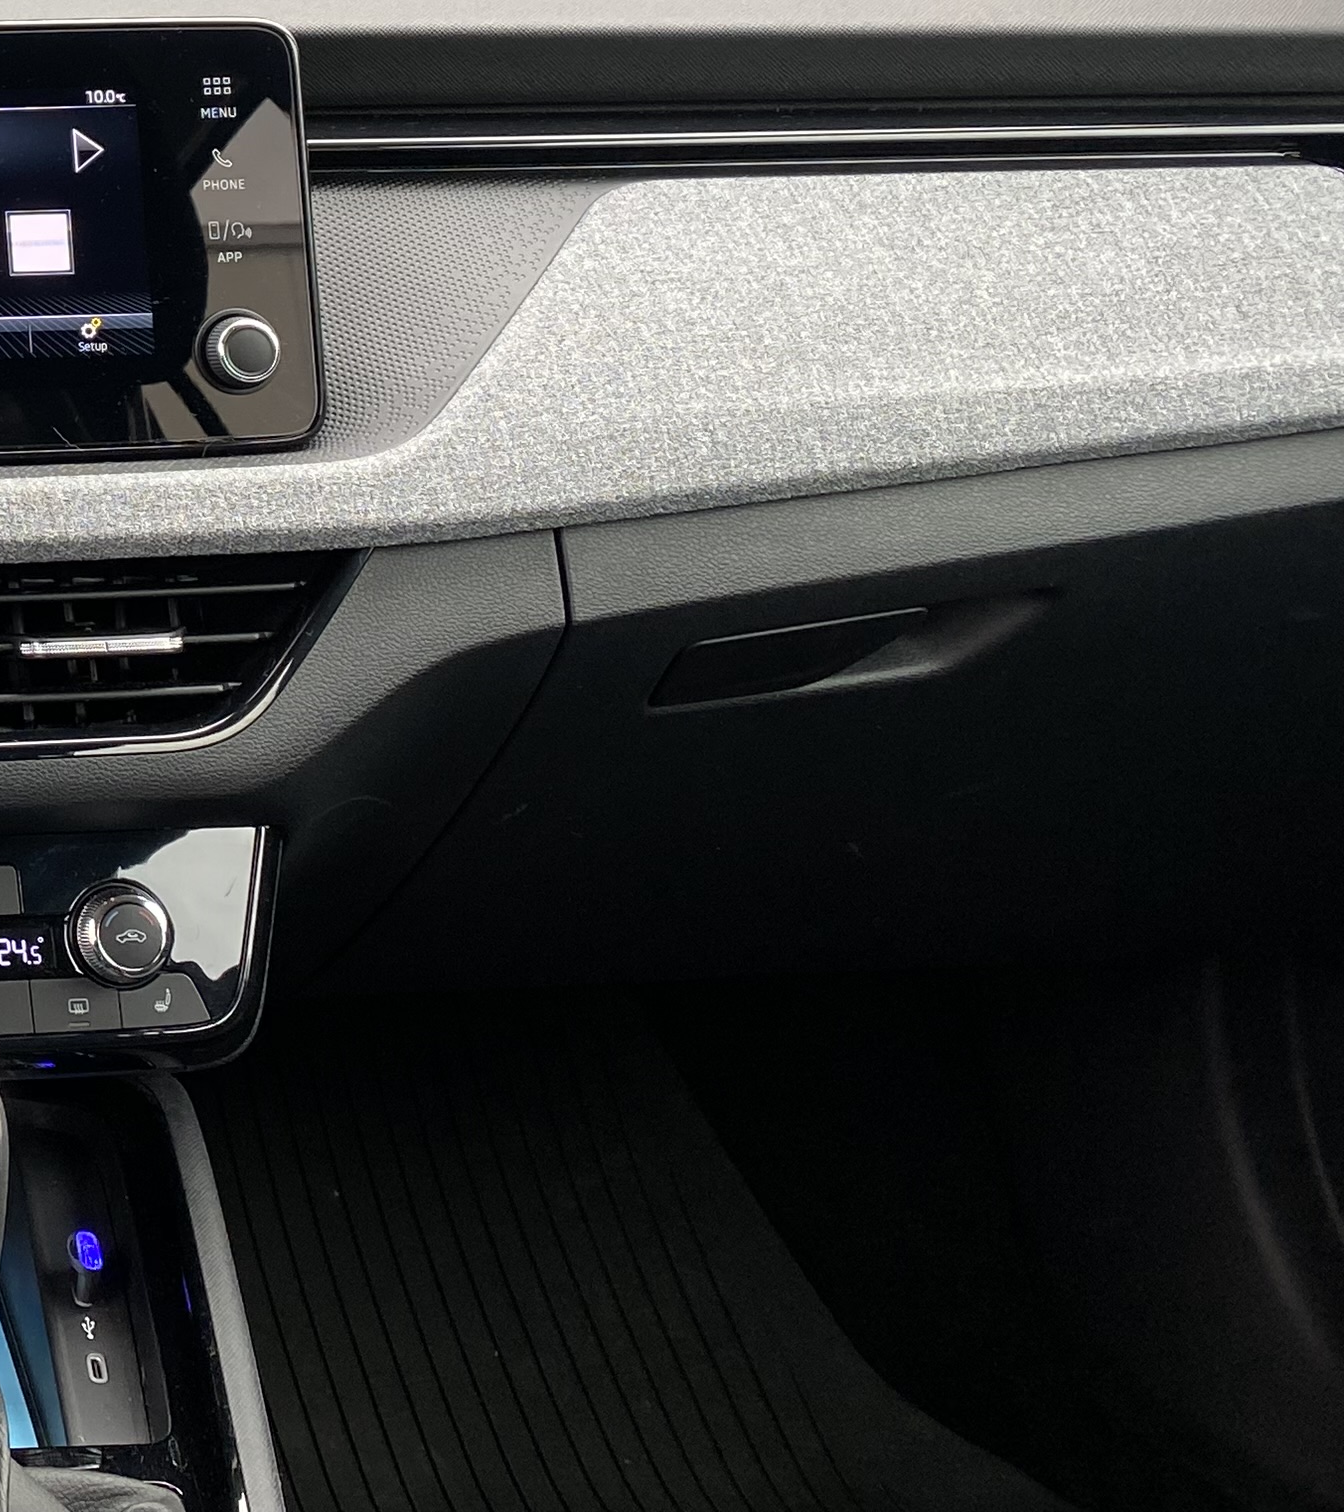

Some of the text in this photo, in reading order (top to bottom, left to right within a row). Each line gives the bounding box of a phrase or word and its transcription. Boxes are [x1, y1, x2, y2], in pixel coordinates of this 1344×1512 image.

[200, 107, 237, 119] MENU
[203, 179, 245, 191] PHONE
[217, 252, 243, 263] APP
[78, 341, 108, 353] Setup
